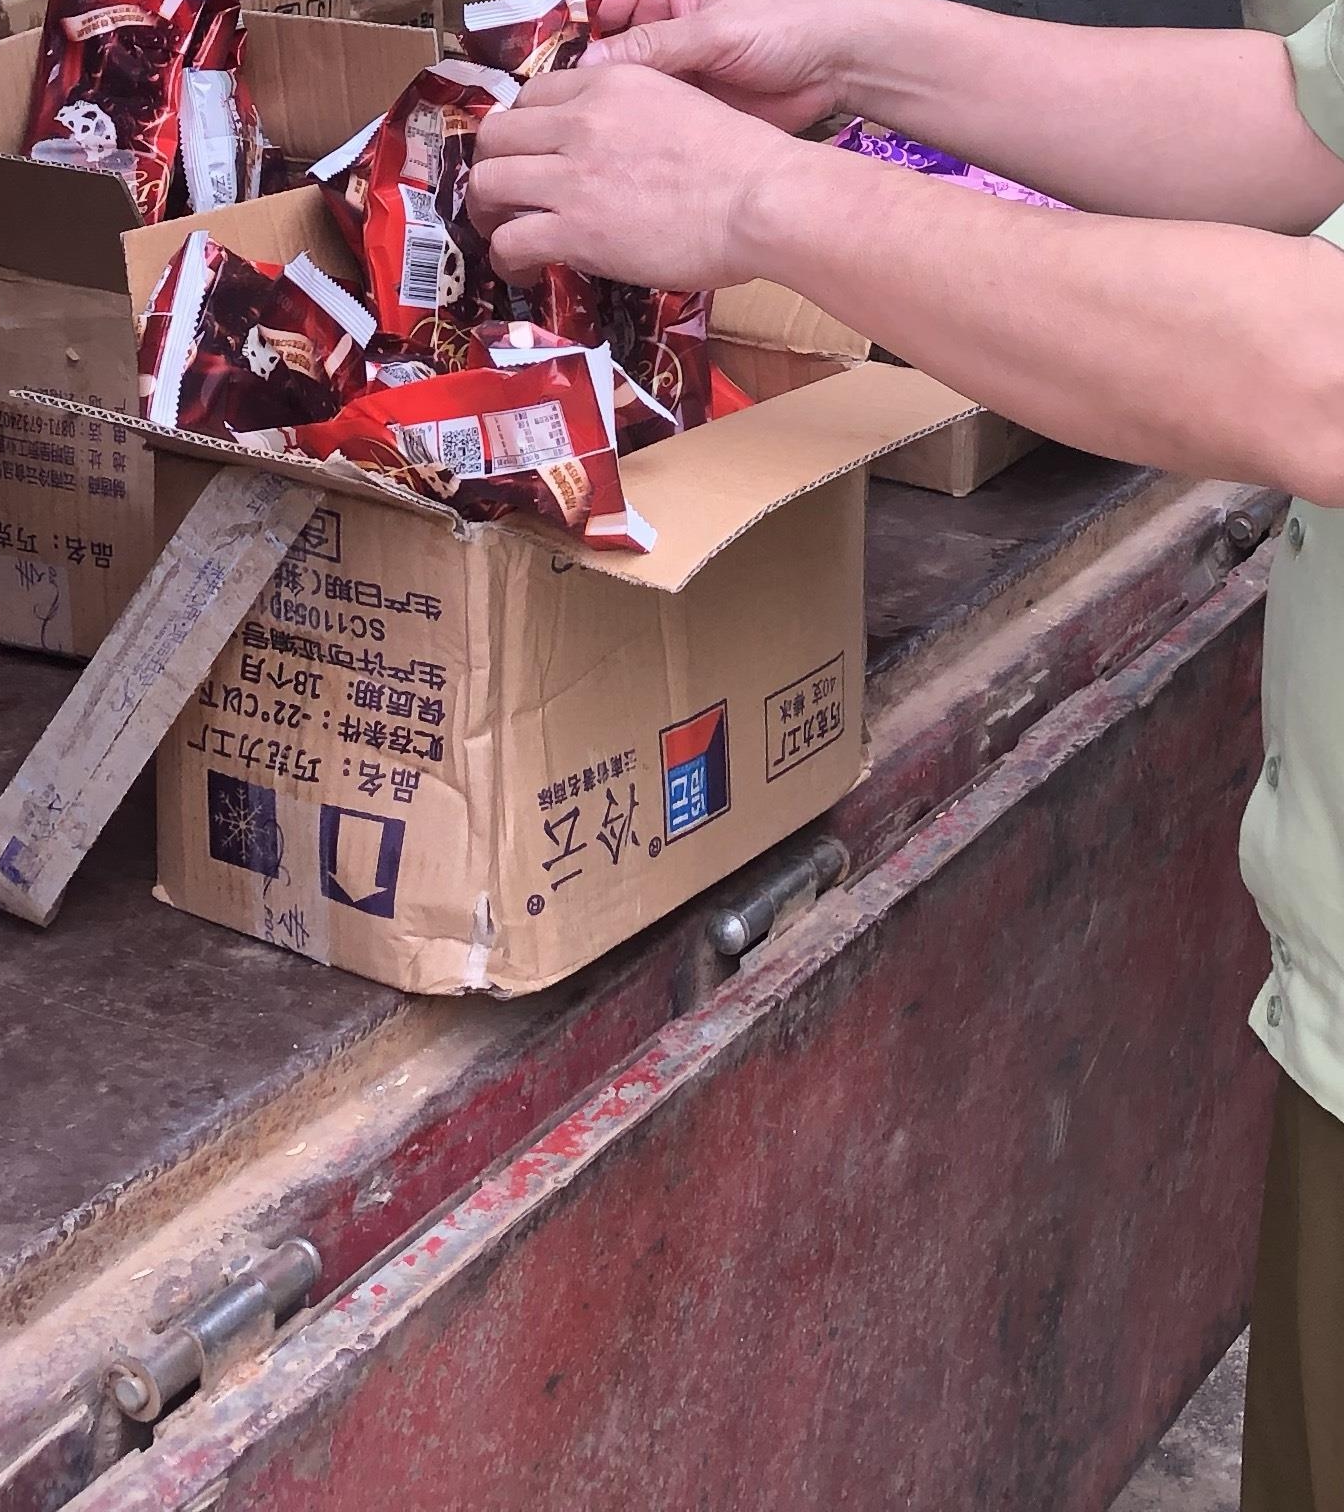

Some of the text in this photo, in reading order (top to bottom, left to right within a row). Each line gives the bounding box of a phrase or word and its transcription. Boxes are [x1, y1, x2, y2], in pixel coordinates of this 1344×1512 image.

[53, 534, 113, 569] 品名：
[240, 654, 446, 727] 保质期： 18个月
[812, 676, 837, 705] 40支
[187, 724, 421, 804] 品名： 巧克力工厂
[773, 701, 841, 767] 巧克力工厂
[537, 748, 638, 811] 云南省著名商标
[541, 783, 641, 893] 冷云
